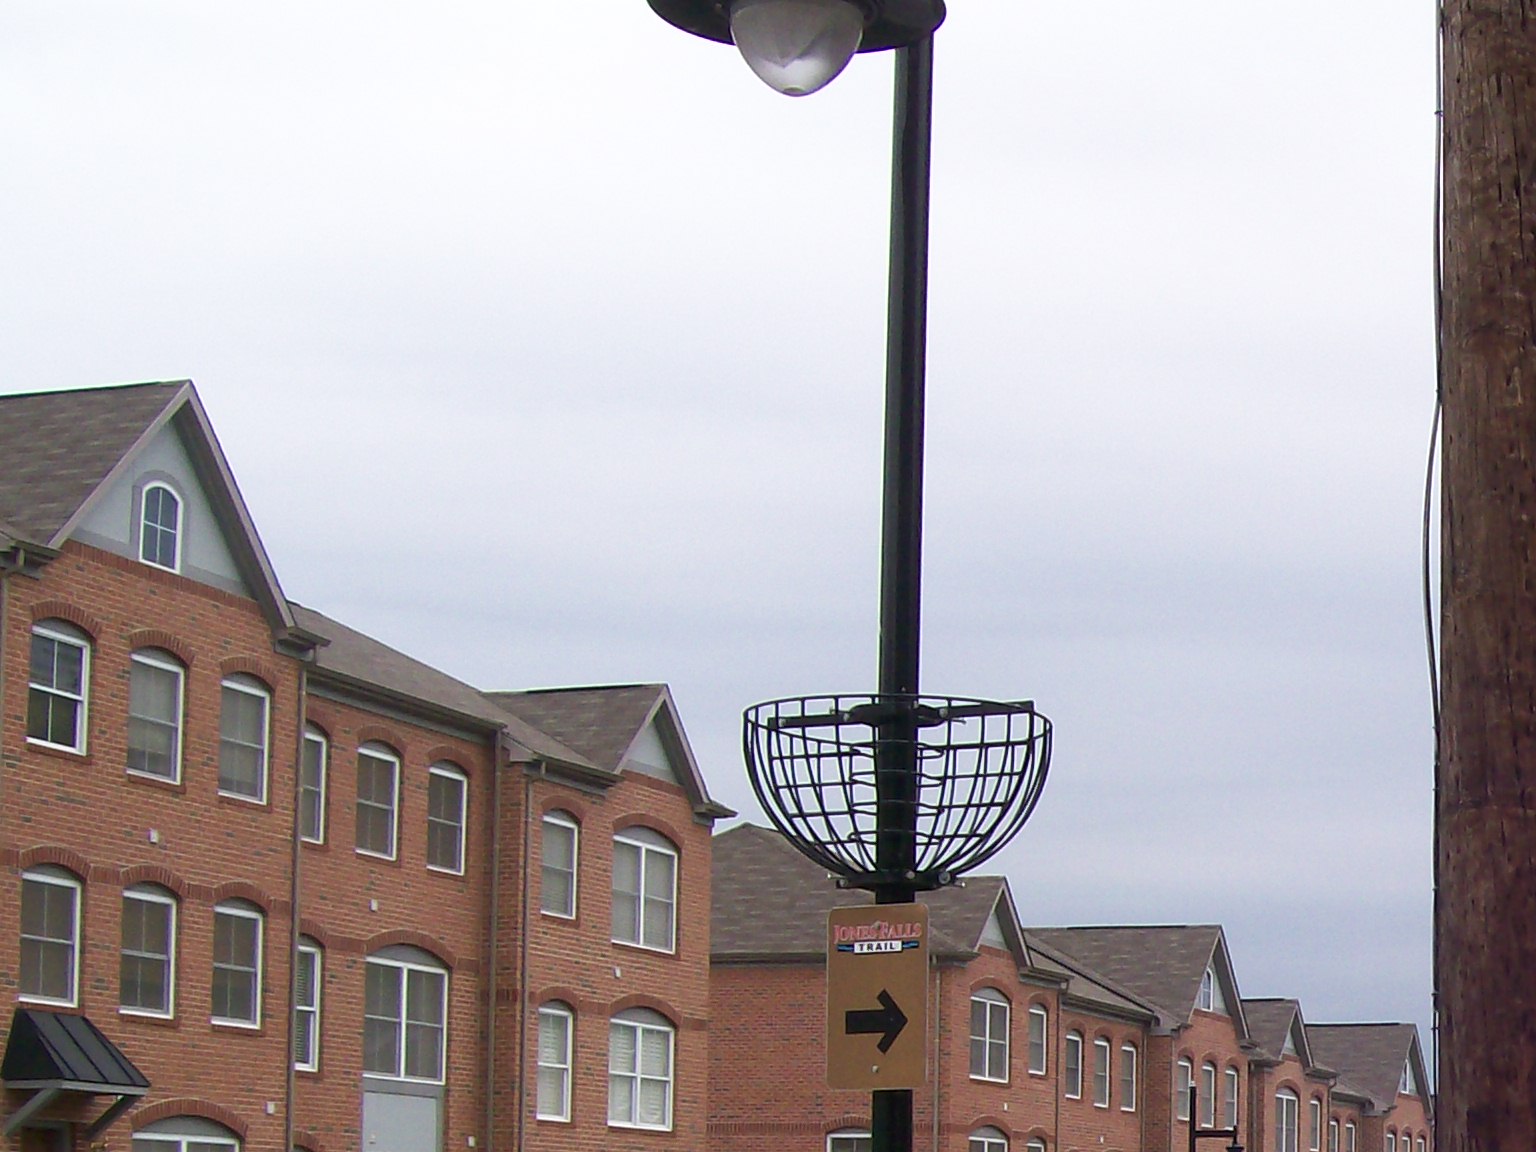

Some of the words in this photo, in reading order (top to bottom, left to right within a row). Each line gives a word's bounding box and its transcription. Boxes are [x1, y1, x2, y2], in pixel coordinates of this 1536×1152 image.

[833, 924, 877, 944] JONES
[878, 921, 922, 940] FALLS
[858, 942, 895, 952] TRAIL
